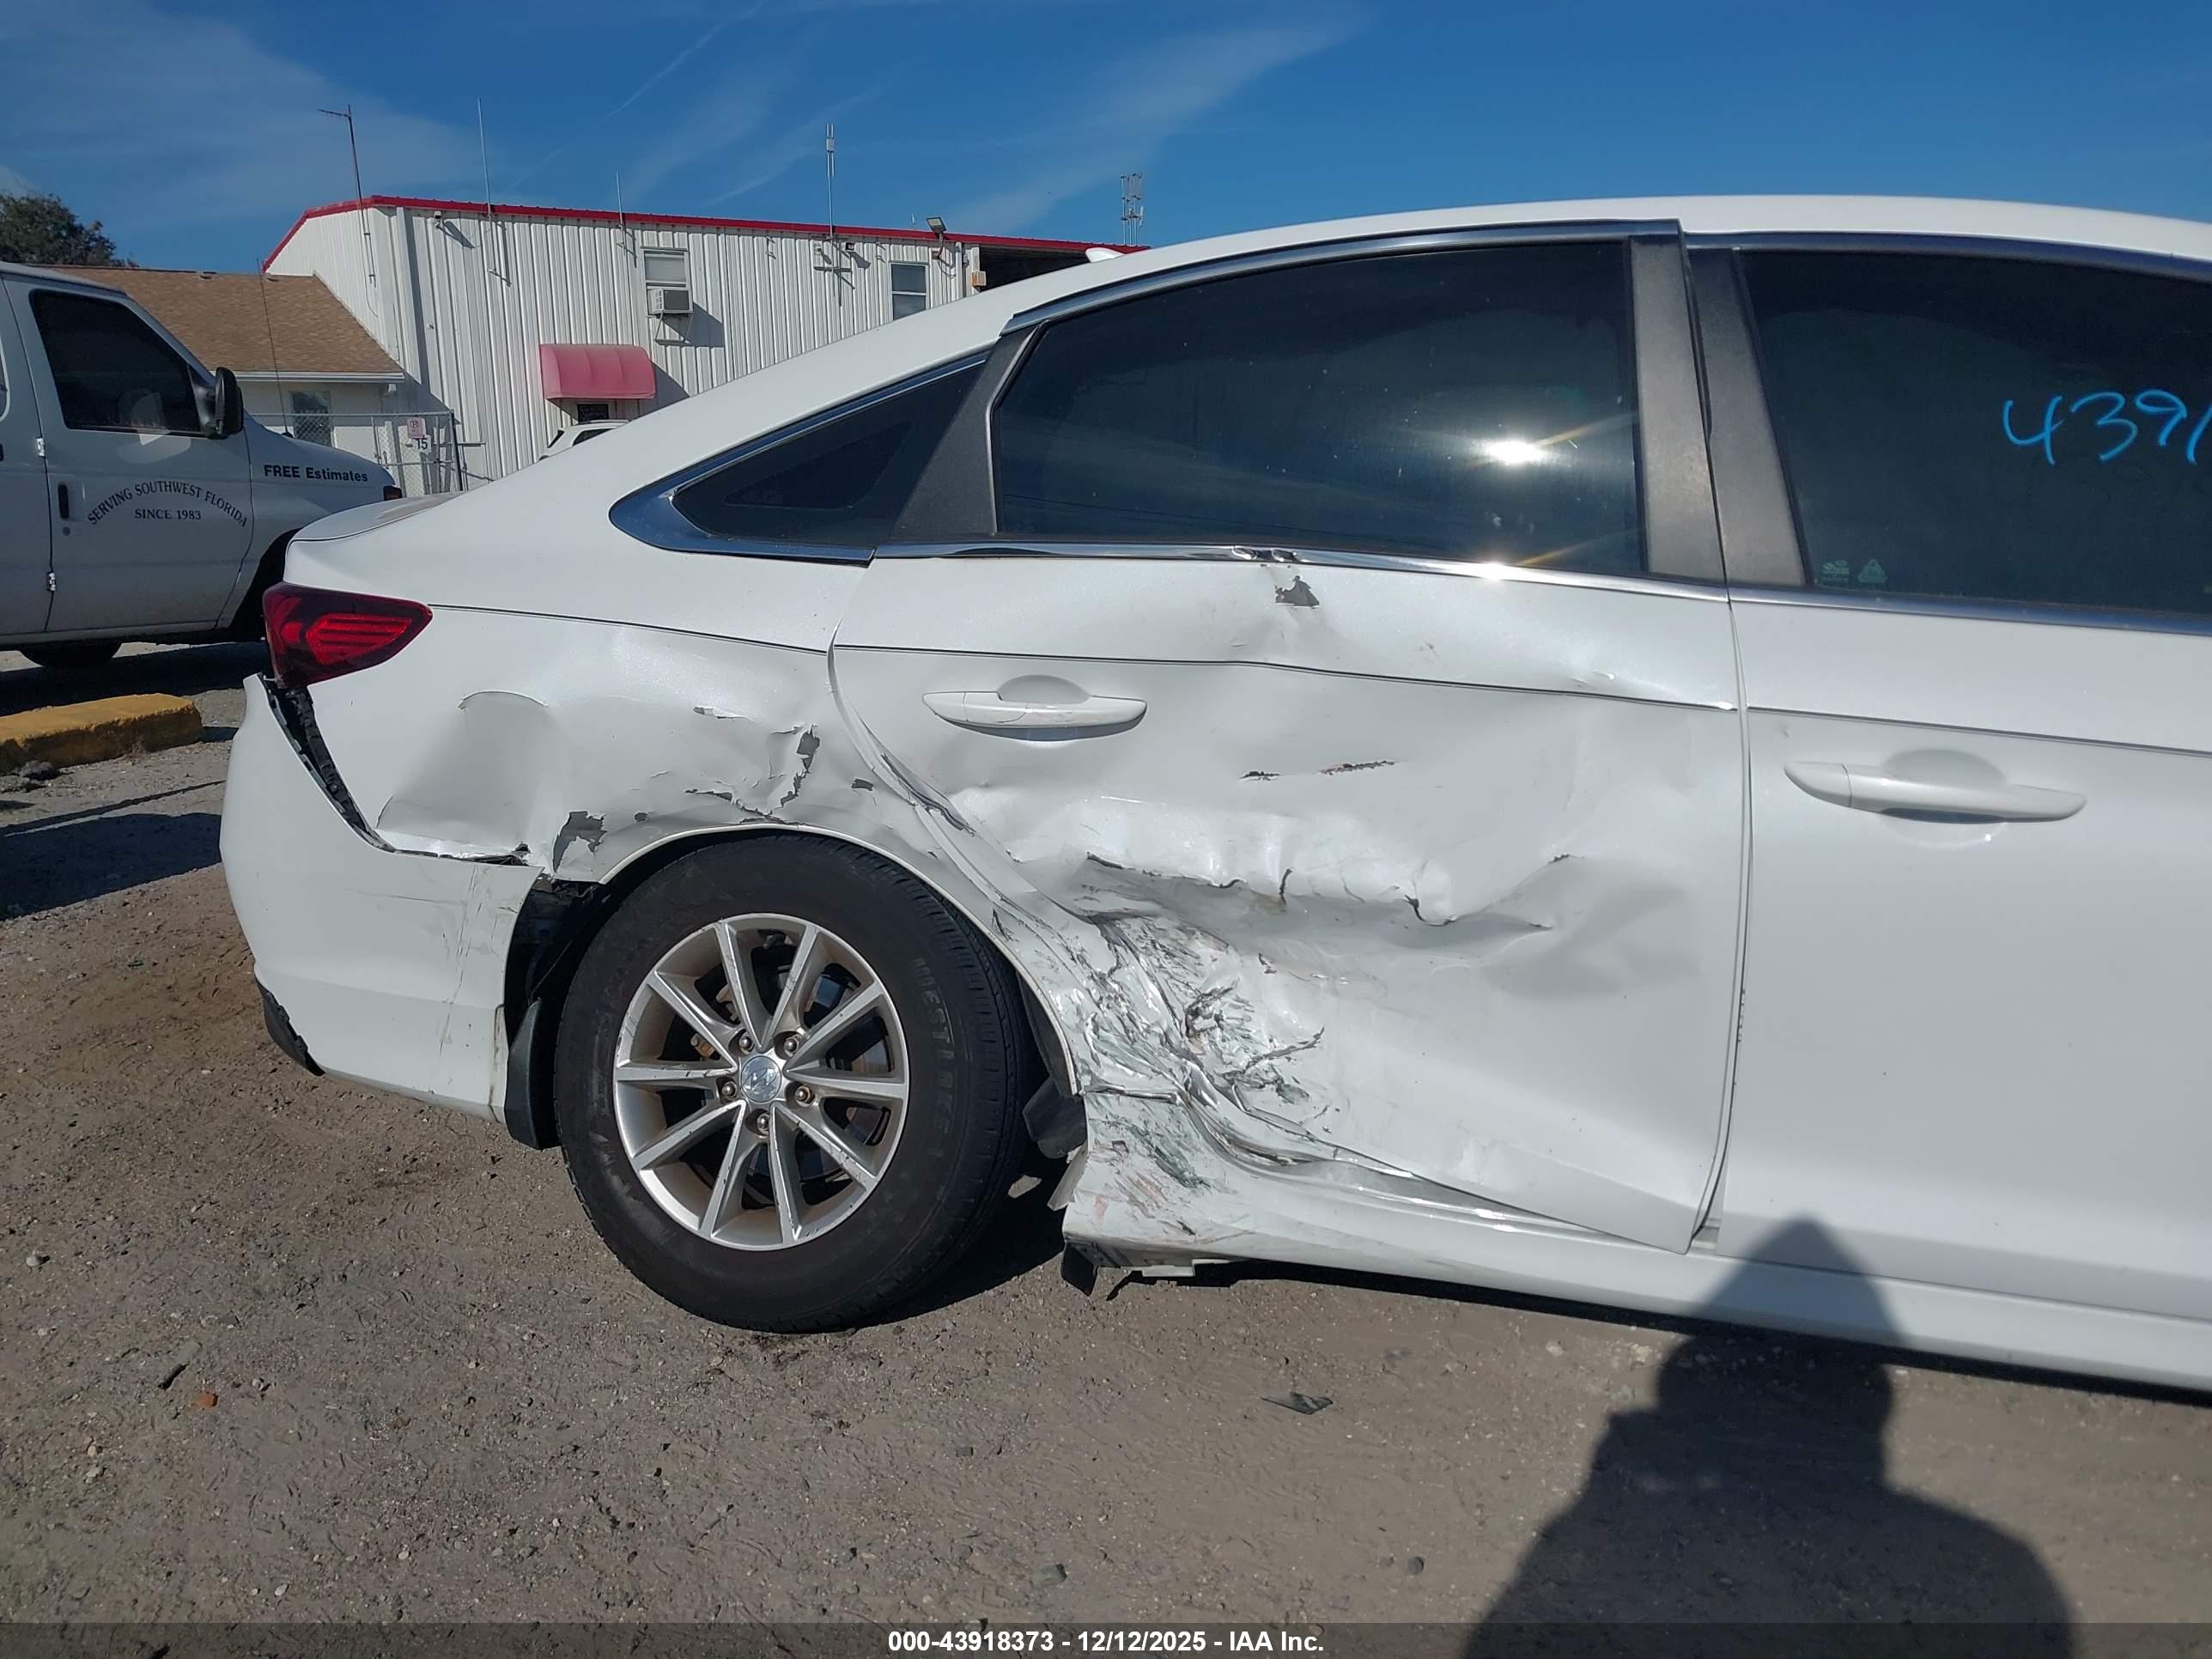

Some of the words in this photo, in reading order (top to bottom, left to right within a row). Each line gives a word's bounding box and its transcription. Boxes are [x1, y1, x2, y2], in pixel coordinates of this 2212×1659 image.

[264, 465, 301, 478] FREE
[306, 466, 368, 482] Estimates
[88, 488, 133, 526] SERVING
[134, 480, 204, 499] SOUTHWEST
[204, 490, 248, 528] FLORIDA
[134, 508, 173, 520] SINCE
[176, 509, 202, 520] 1983
